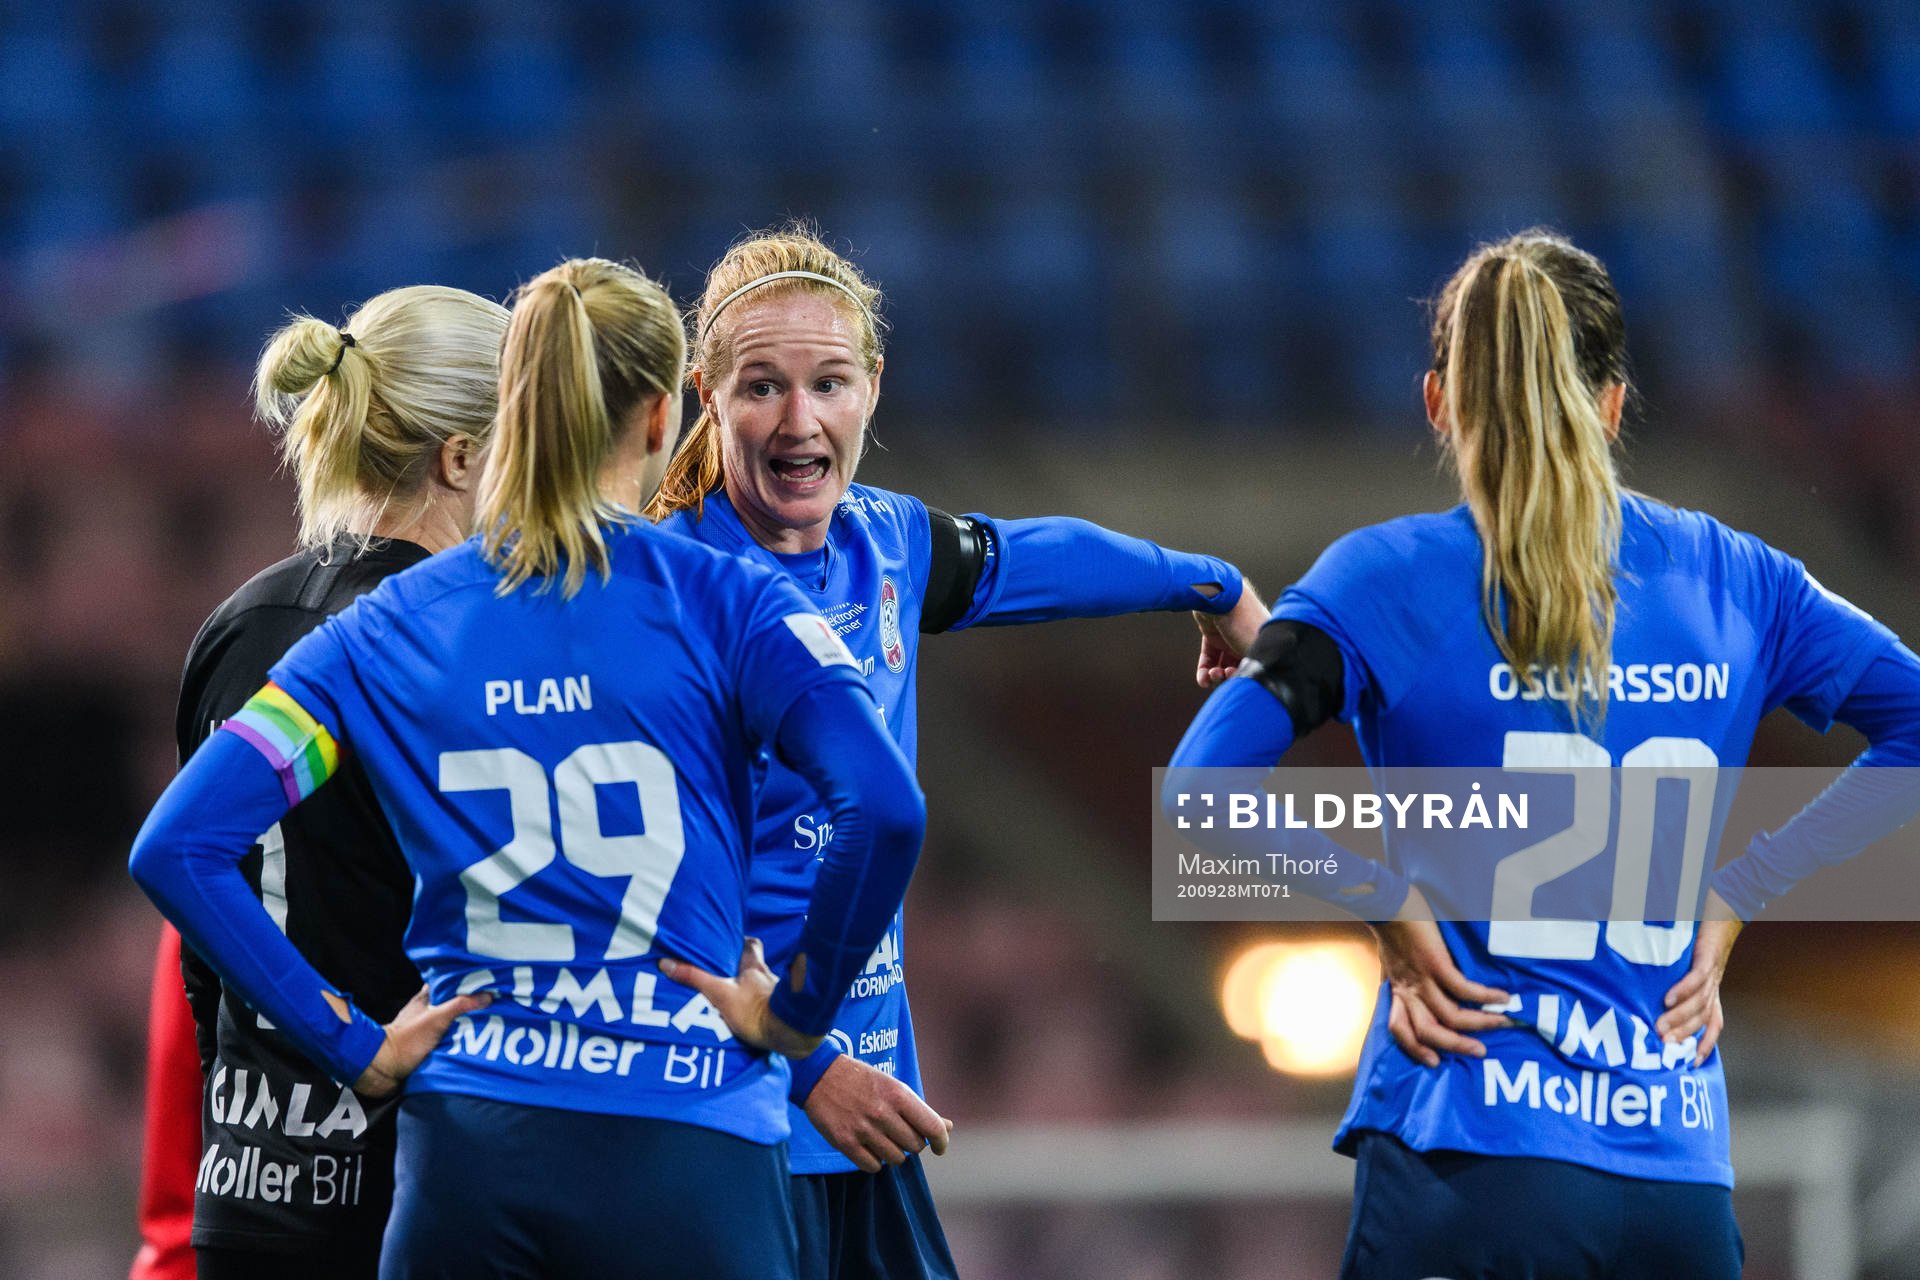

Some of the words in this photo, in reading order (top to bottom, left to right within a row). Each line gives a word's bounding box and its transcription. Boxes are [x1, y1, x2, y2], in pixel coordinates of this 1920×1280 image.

[833, 619, 862, 637] artner
[485, 674, 593, 716] PLAN
[439, 740, 686, 961] 29
[1487, 731, 1719, 967] 20
[664, 1044, 725, 1089] Bil
[1680, 1075, 1714, 1131] Bil
[313, 1155, 362, 1206] Bil
